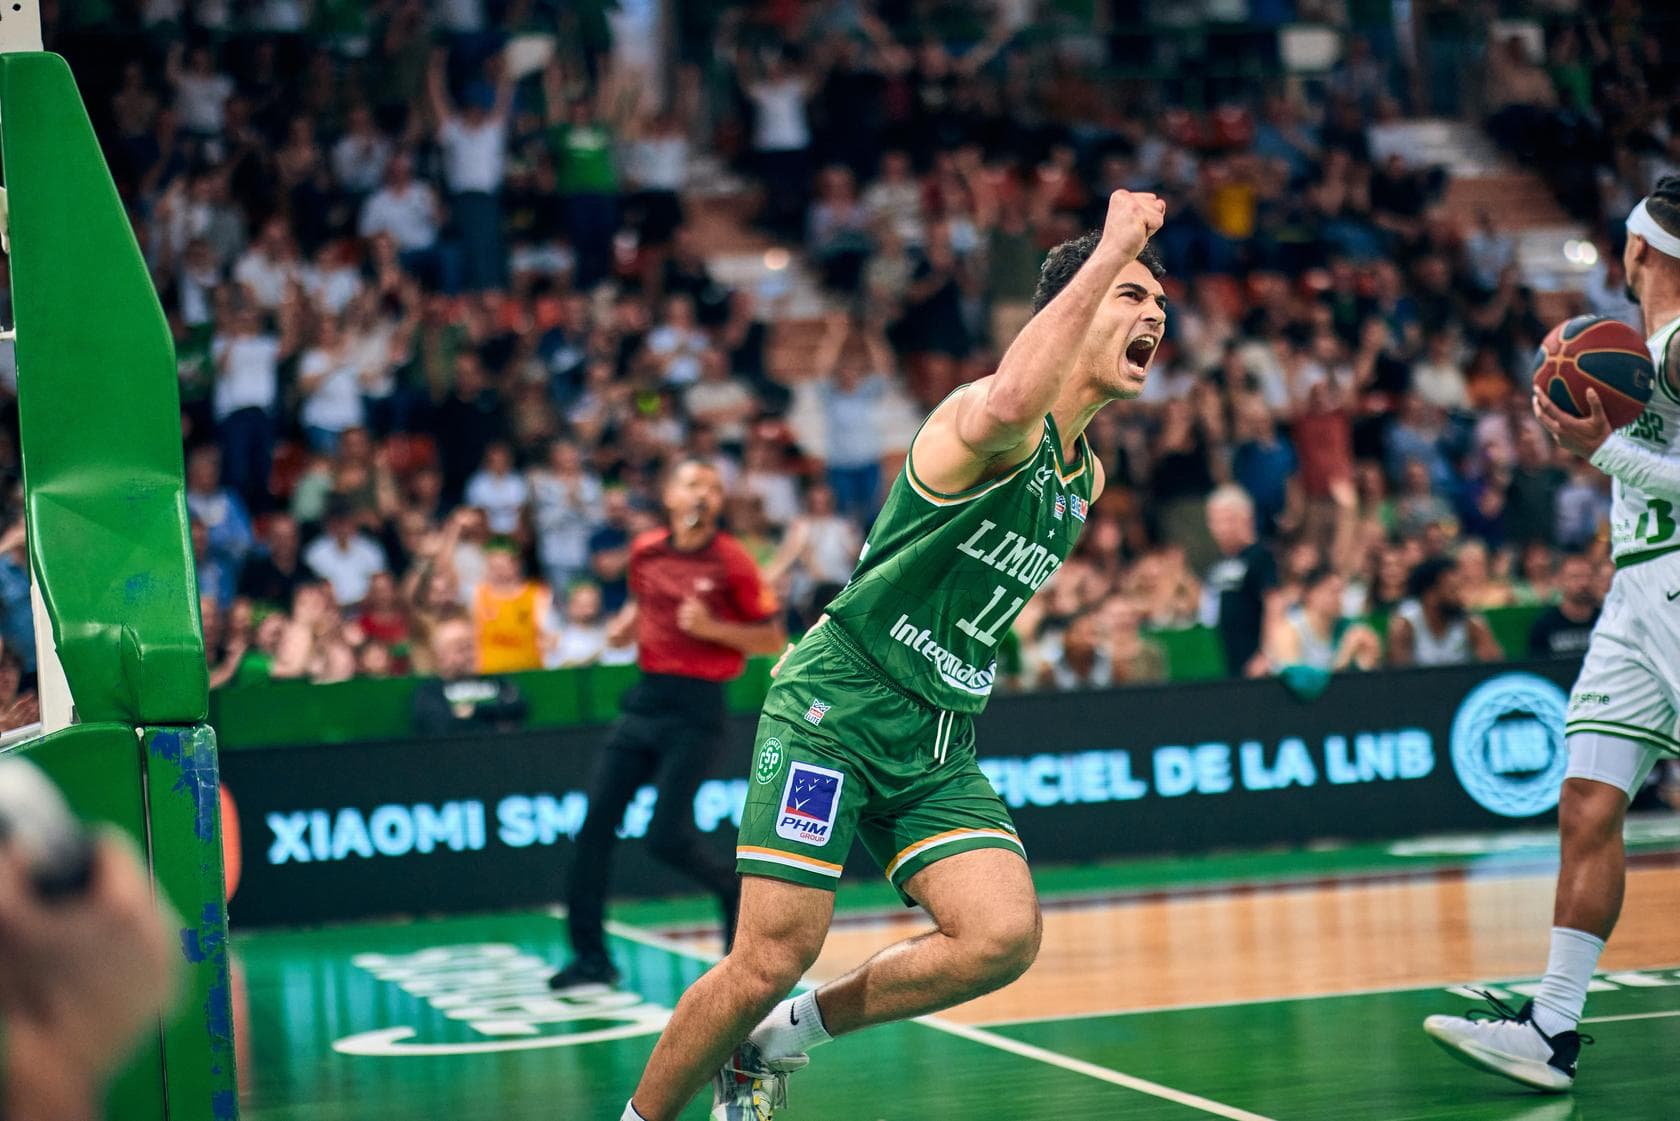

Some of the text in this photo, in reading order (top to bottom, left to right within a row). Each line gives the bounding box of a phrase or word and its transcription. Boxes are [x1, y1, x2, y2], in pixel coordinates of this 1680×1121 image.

[957, 519, 1063, 591] LIMOG
[955, 584, 1024, 647] 11
[758, 746, 780, 770] CSP
[266, 799, 486, 864] XIAOMI
[979, 749, 1147, 809] FICIEL
[1153, 742, 1232, 796] DE
[1239, 737, 1316, 790] LA
[1324, 728, 1434, 784] LNB
[780, 816, 828, 836] PHM
[799, 832, 825, 842] GROUP
